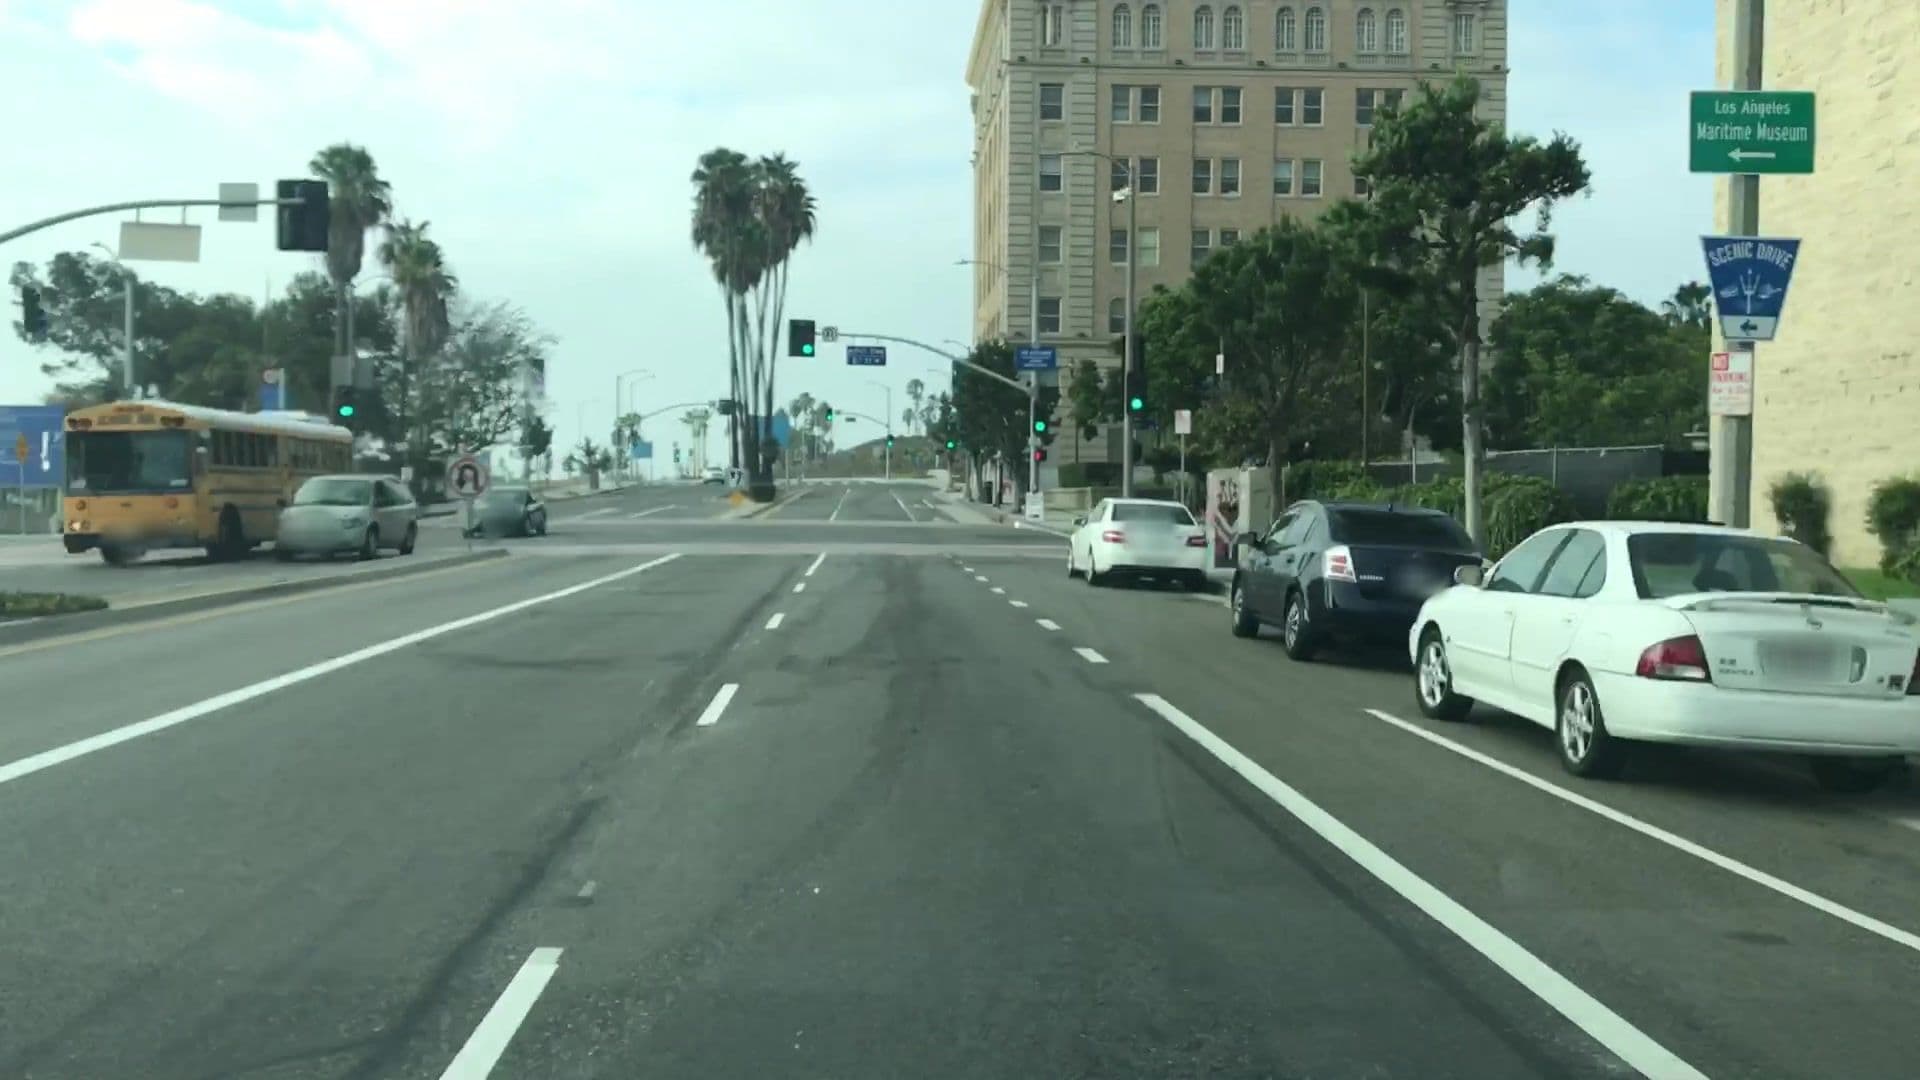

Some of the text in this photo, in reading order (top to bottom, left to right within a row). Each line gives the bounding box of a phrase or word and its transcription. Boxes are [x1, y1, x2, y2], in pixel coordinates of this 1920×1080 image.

[1715, 100, 1790, 118] Los Angeles
[1696, 122, 1808, 141] Maritime Museum
[1709, 242, 1793, 270] SCENIC DRIVE
